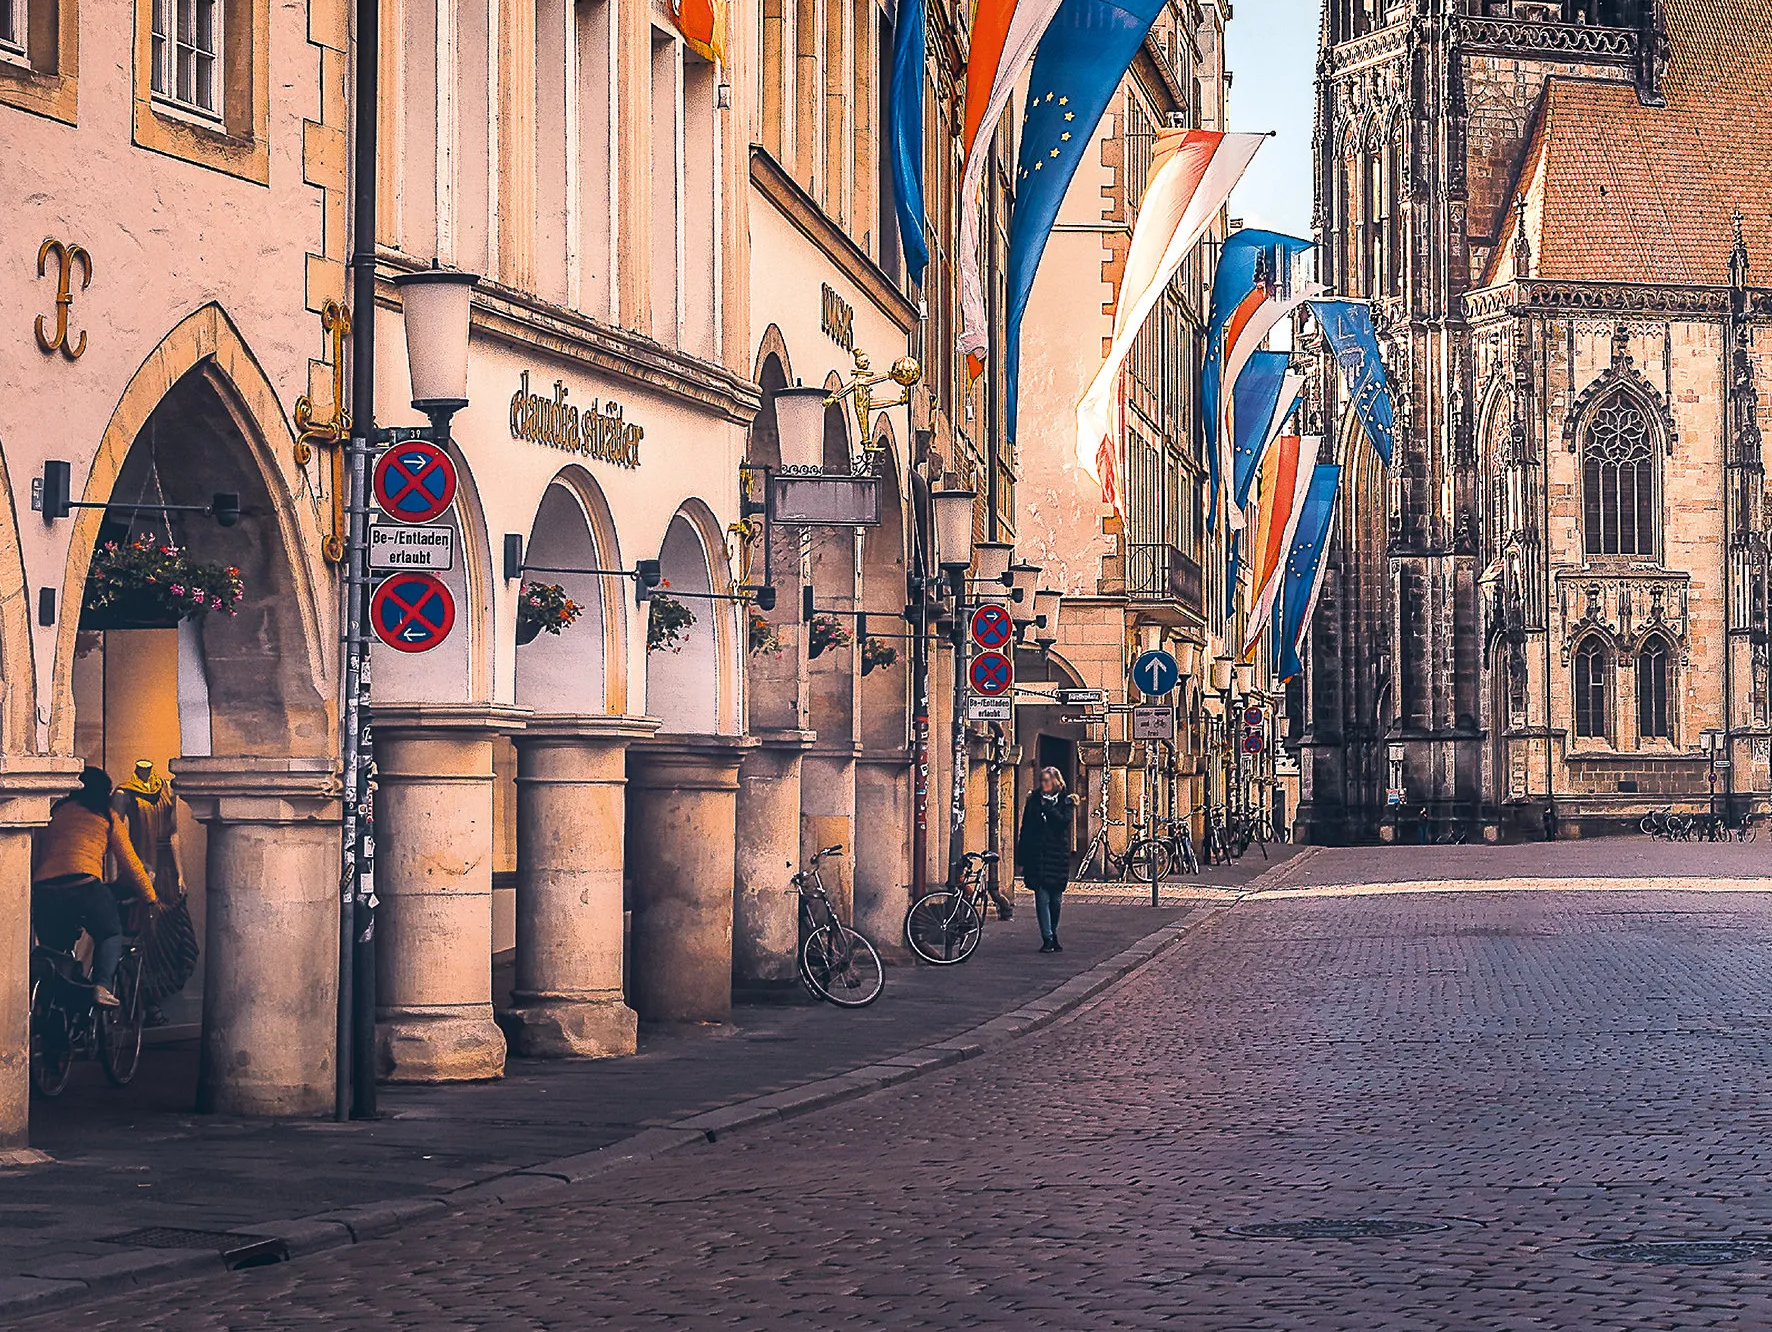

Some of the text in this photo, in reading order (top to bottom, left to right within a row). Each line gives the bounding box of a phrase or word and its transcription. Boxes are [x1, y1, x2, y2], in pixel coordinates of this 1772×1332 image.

[510, 370, 580, 453] claudia
[410, 429, 421, 439] 39
[372, 530, 449, 547] Be-/Entladen
[389, 550, 431, 565] erlaubt
